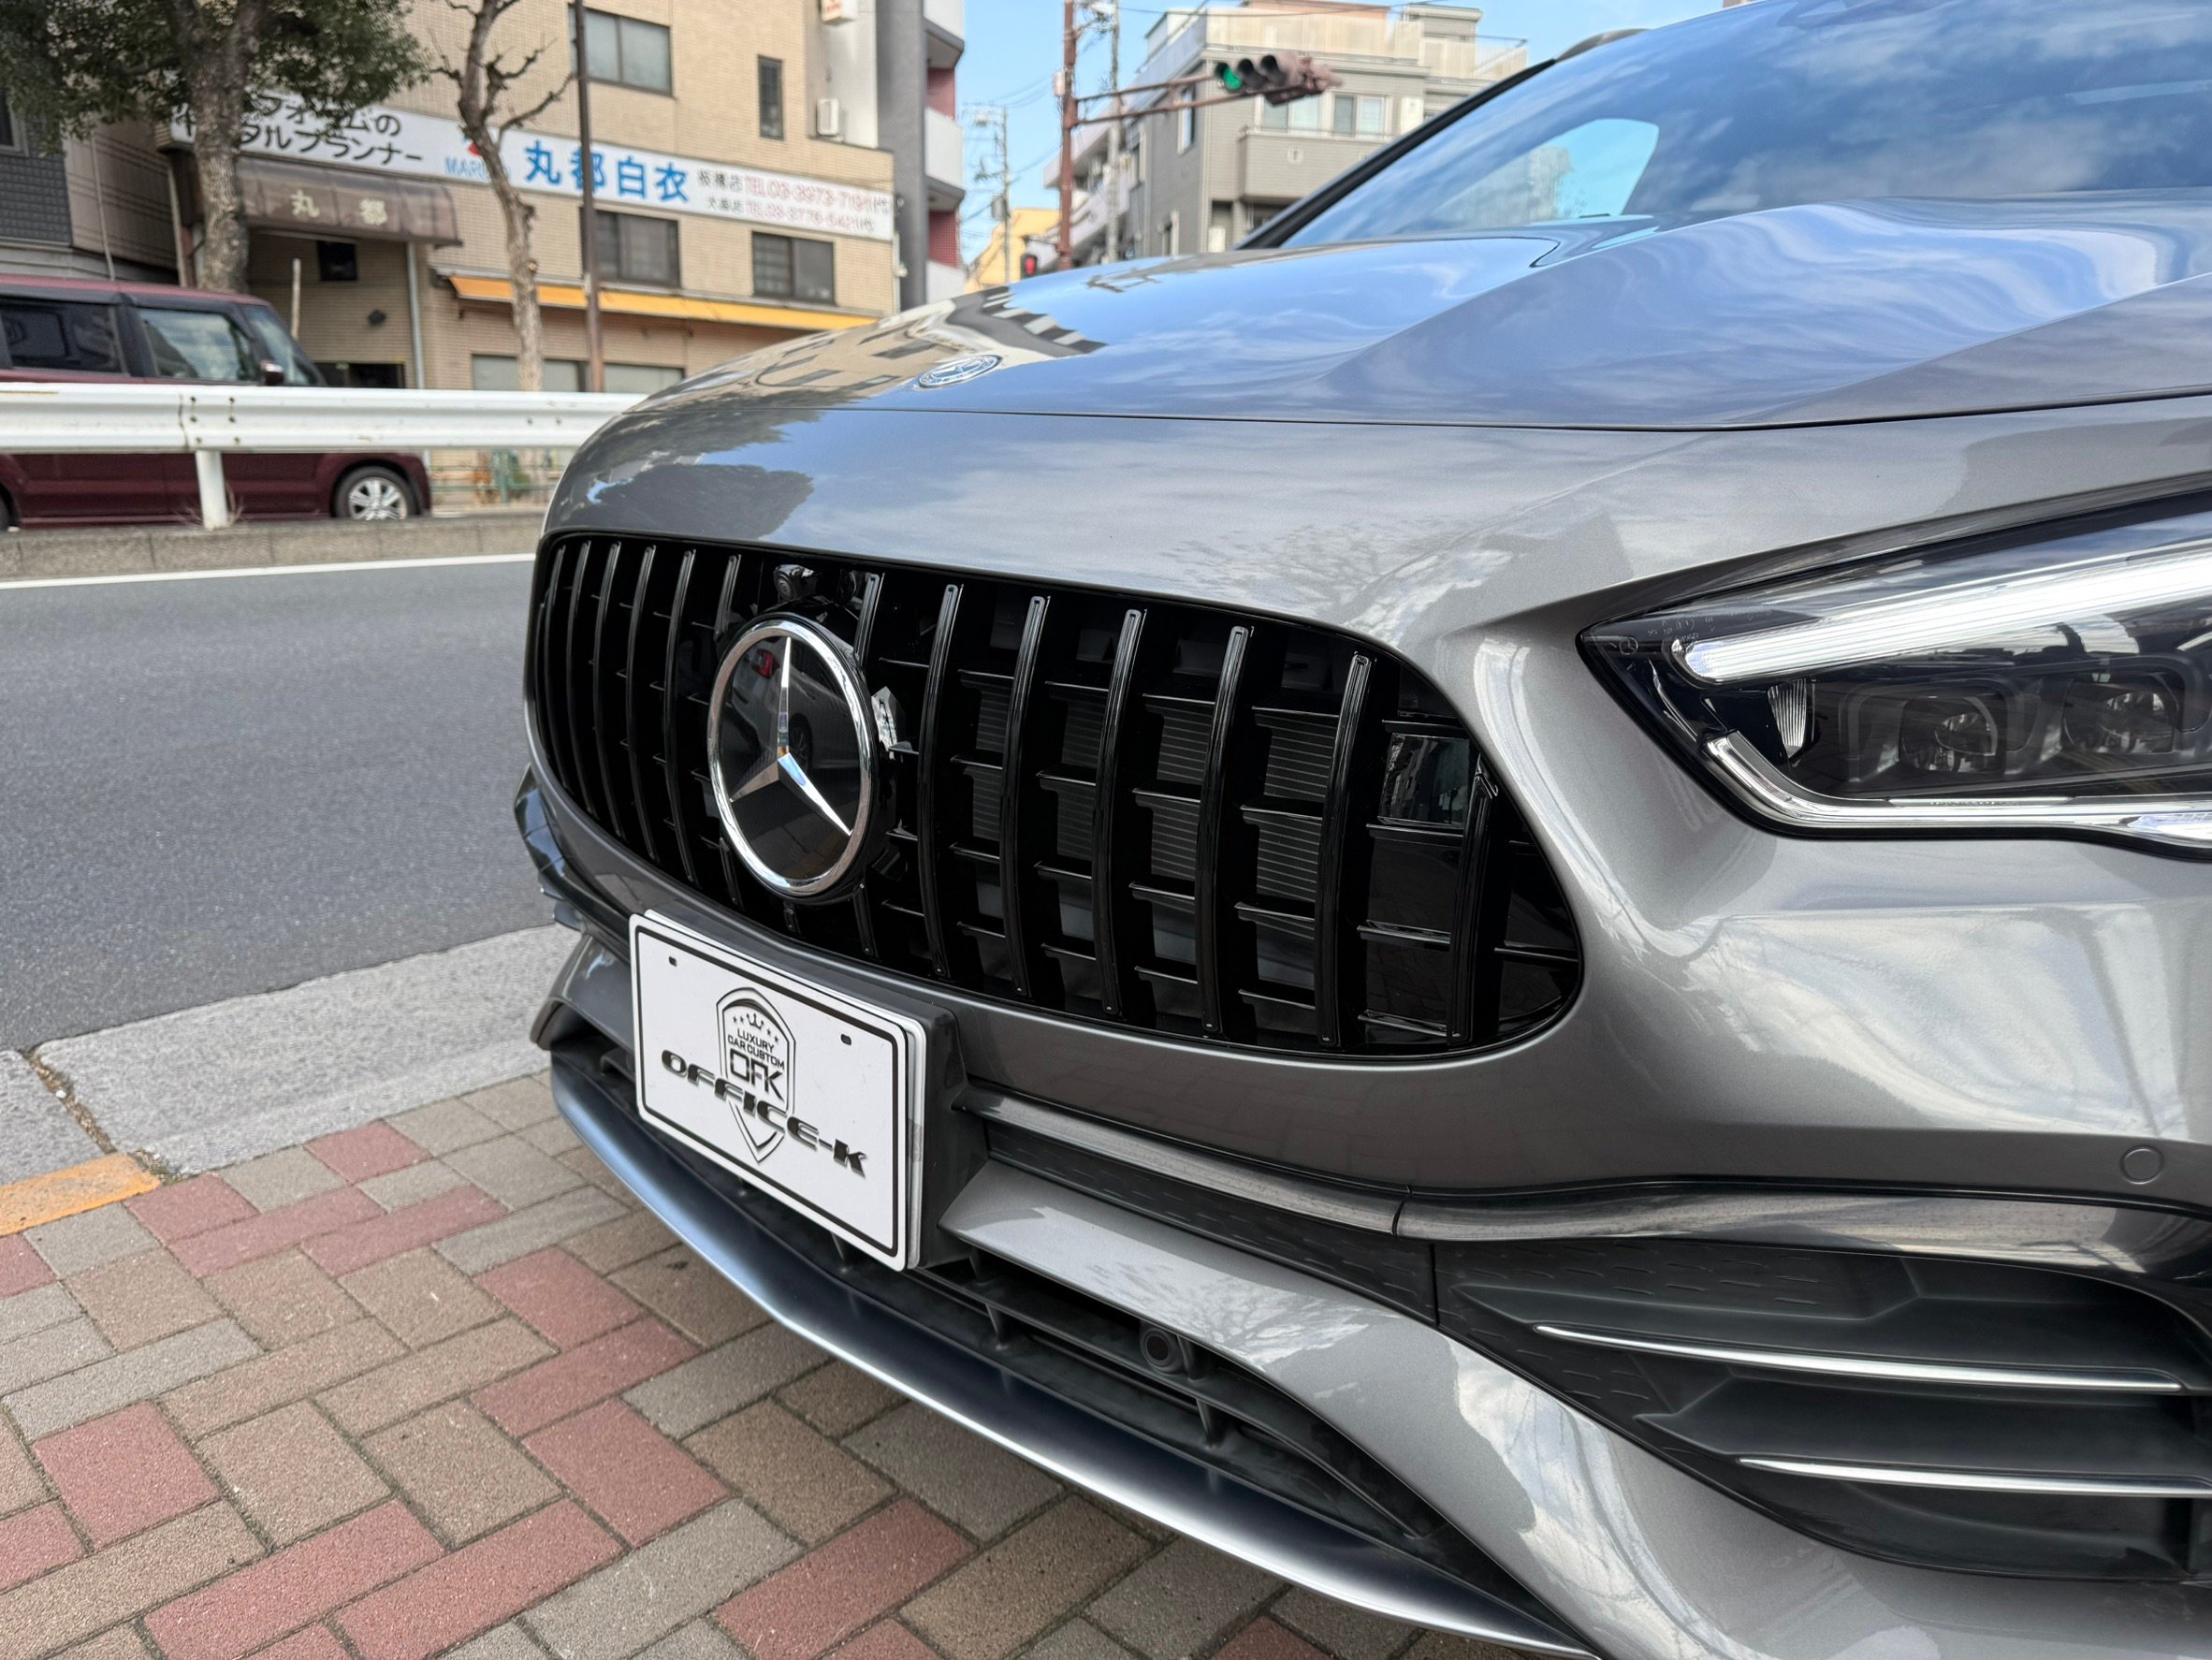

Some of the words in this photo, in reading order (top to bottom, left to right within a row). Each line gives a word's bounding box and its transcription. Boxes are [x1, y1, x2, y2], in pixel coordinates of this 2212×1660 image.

[444, 156, 512, 182] MARU
[524, 138, 690, 203] 丸都白衣
[727, 1035, 747, 1050] CAR
[747, 1043, 785, 1069] CUSTOM
[736, 1027, 775, 1050] LUXURY
[661, 1049, 867, 1177] OFFICE-K
